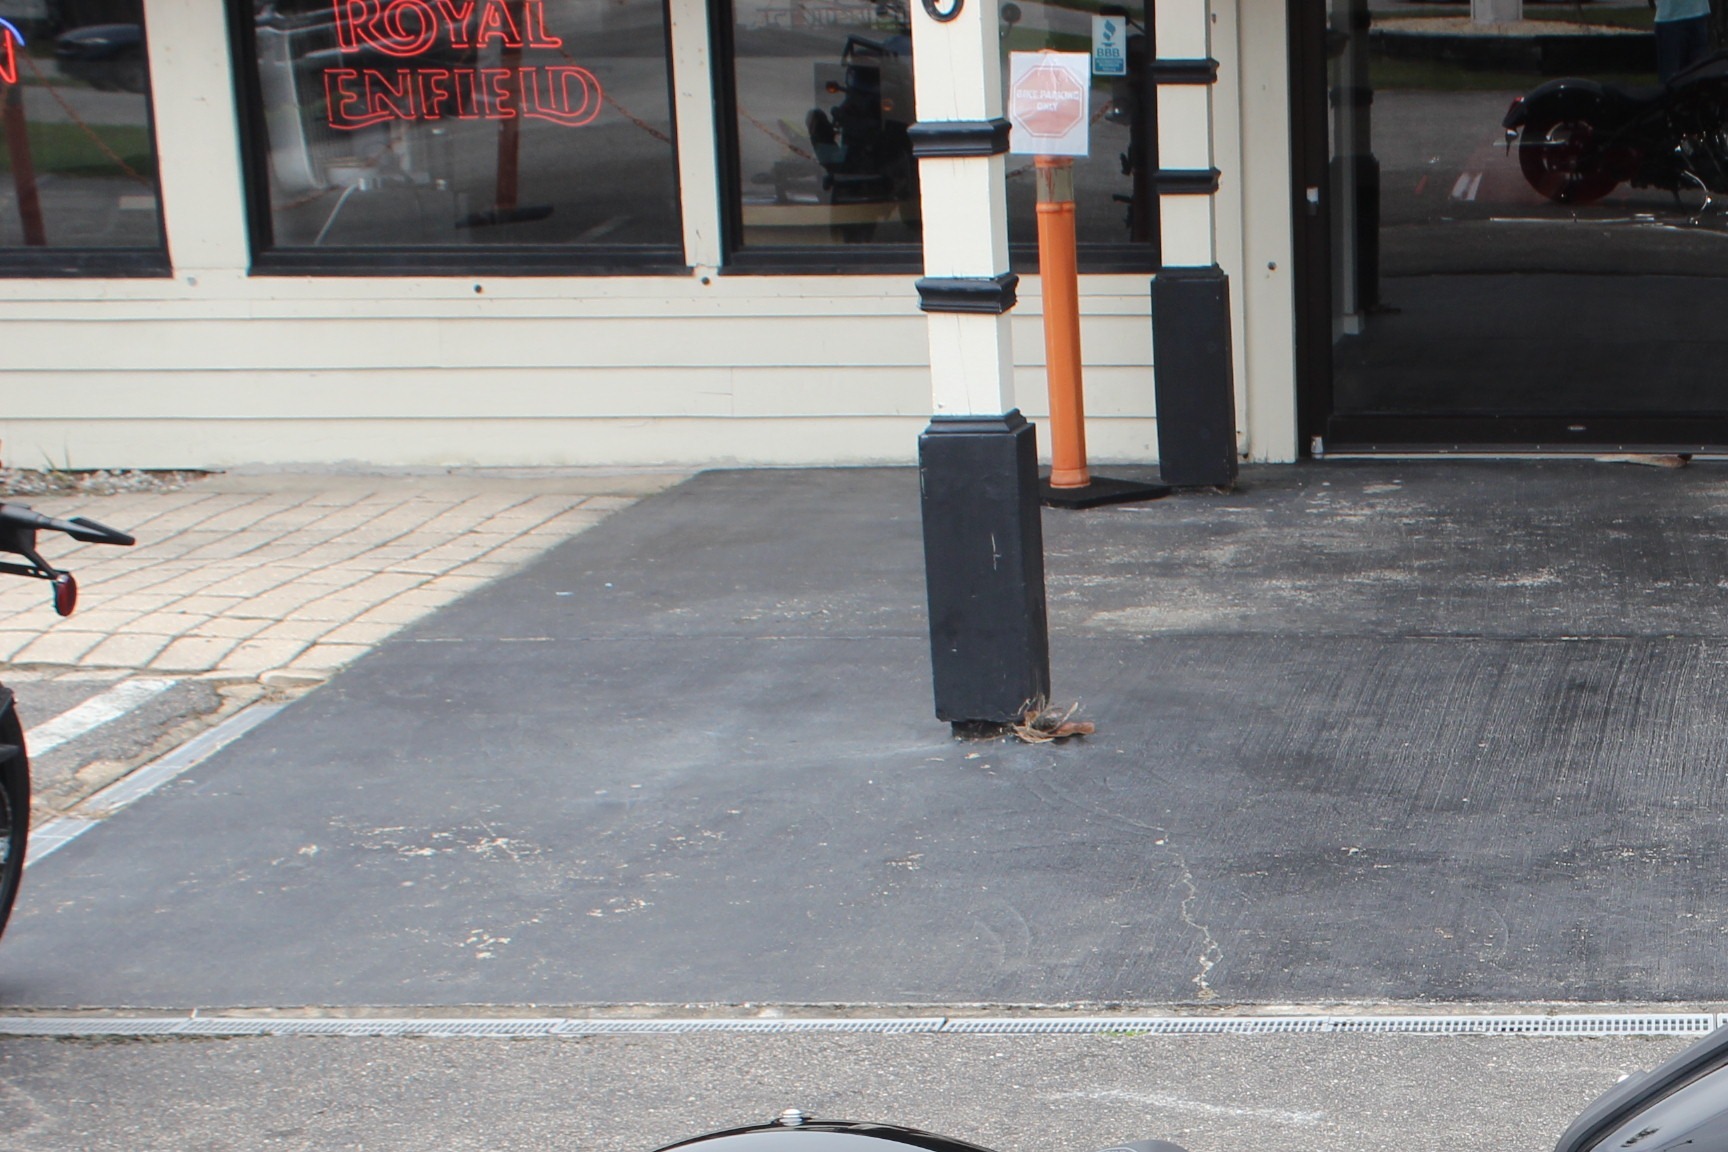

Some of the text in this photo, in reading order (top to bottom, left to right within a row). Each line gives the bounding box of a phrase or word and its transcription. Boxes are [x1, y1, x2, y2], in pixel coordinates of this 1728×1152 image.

[333, 0, 563, 57] ROYAL
[1097, 48, 1120, 57] BBB
[323, 66, 604, 130] ENFIELD
[1017, 89, 1080, 101] BIKE PARKING
[1036, 102, 1058, 112] ONLY
